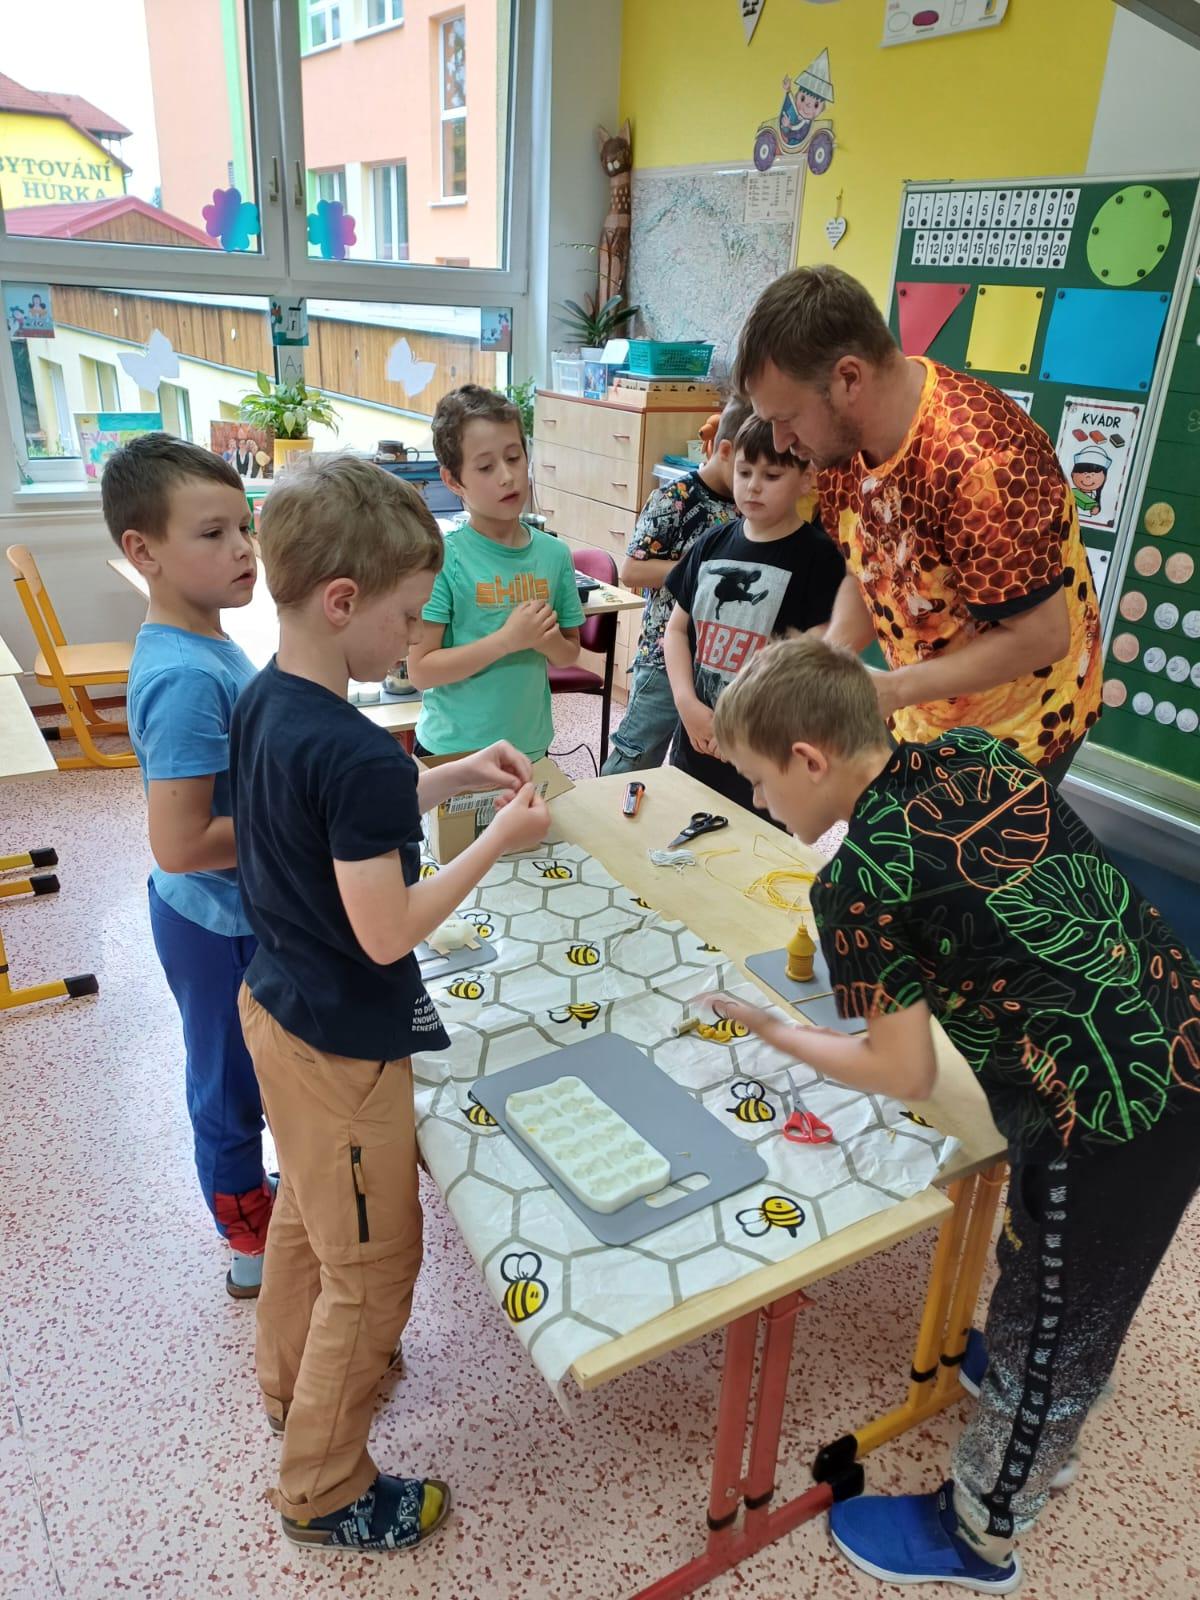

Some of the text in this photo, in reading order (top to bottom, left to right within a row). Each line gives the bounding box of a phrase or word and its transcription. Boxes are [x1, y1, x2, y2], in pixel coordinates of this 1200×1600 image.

[916, 243, 1067, 257] 11 12 13 14 15 16 17 18 19 20
